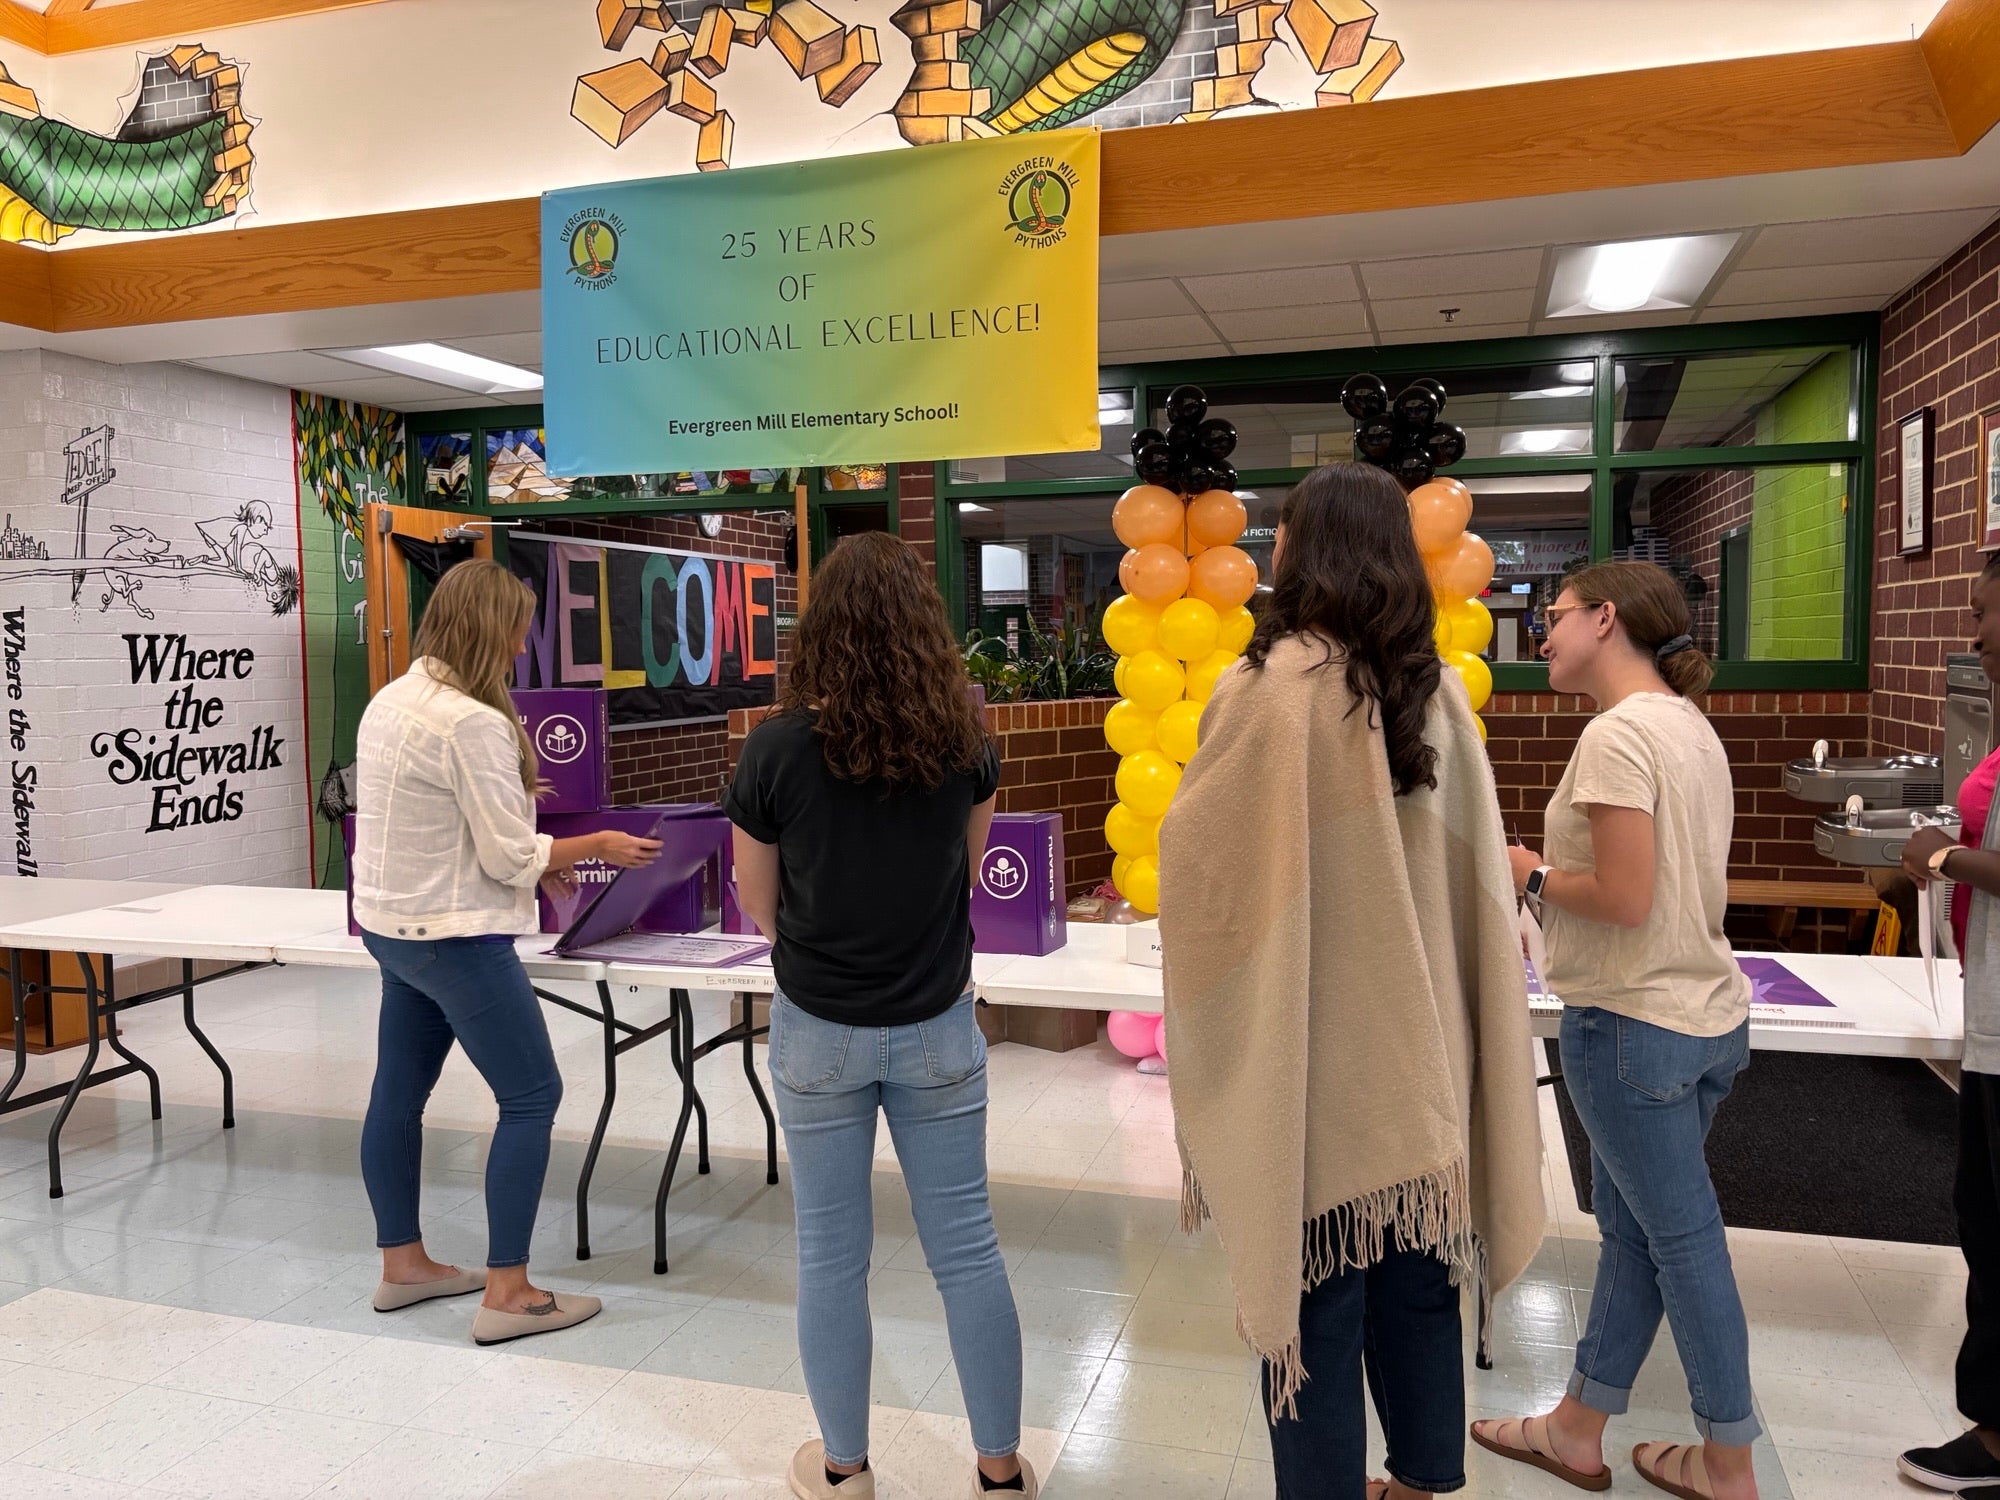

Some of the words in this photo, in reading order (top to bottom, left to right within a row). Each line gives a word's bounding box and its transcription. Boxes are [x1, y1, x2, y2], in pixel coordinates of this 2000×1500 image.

[998, 156, 1055, 196] EVERGREEN
[1057, 161, 1080, 189] MILL
[559, 207, 606, 243] EVERGREEN
[608, 212, 628, 237] MILL
[721, 231, 757, 260] 25
[778, 218, 876, 254] YEARS
[1014, 227, 1067, 249] PYTHONS
[573, 271, 618, 291] PYTHONS
[778, 273, 817, 302] OF
[597, 323, 803, 364] EDUCATIONAL
[822, 302, 1040, 347] EXCELLENCE!
[668, 416, 752, 437] Evergreen
[757, 413, 788, 431] Mill
[791, 408, 890, 428] Elementary
[893, 402, 959, 422] School!
[69, 438, 103, 484] EDGE
[67, 481, 83, 496] KEEP
[85, 471, 106, 486] OFF!
[355, 473, 389, 509] The
[1250, 527, 1278, 537] FICTIO
[517, 540, 776, 689] WELCOME
[2, 605, 27, 701] Where
[121, 633, 255, 685] Where
[164, 682, 224, 735] the
[8, 708, 32, 752] the
[90, 724, 286, 785] Sidewalk
[144, 778, 244, 835] Ends
